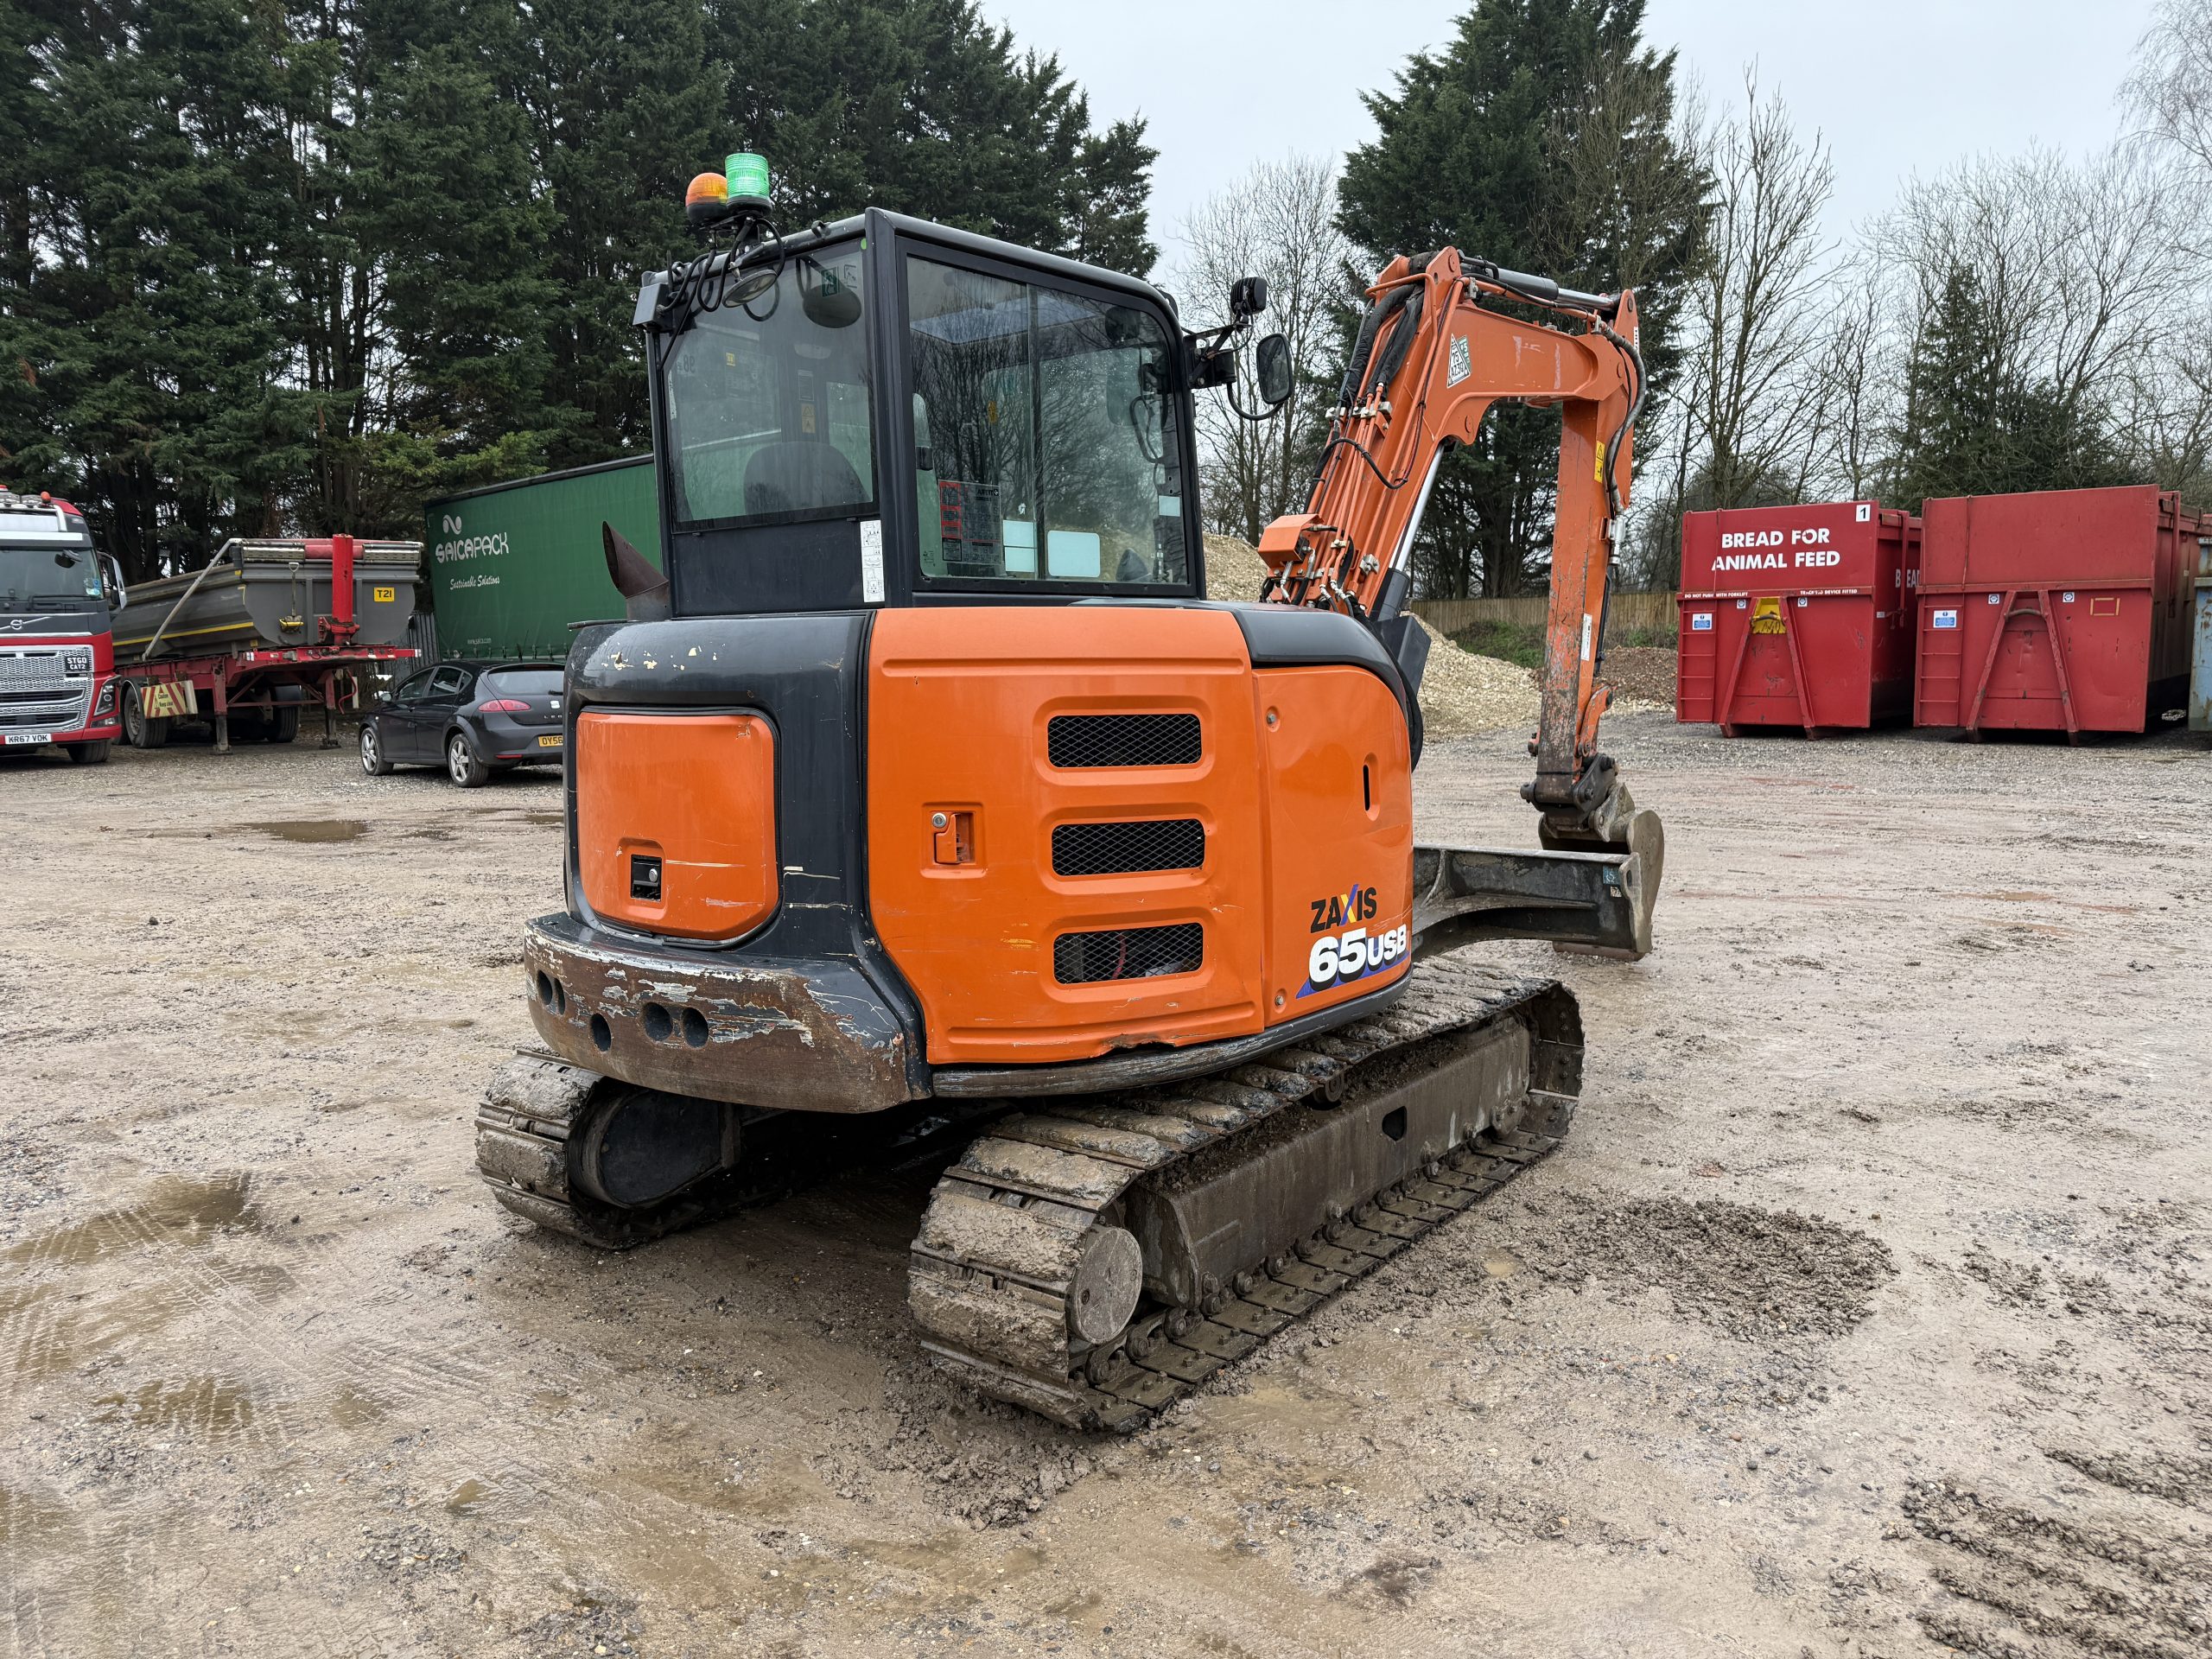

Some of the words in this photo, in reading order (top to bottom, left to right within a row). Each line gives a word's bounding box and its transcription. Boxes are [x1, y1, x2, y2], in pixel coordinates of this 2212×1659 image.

[1859, 507, 1866, 519] 1
[435, 531, 509, 563] SAICAPACK
[1721, 531, 1783, 549] BREAD
[1791, 528, 1830, 545] FOR
[1711, 552, 1788, 570] ANIMAL
[1795, 550, 1840, 568] FEED
[477, 575, 500, 587] Solutions
[1895, 569, 1920, 588] BEA
[377, 589, 392, 598] T21
[1310, 883, 1377, 933] ZAXIS
[1308, 924, 1408, 989] 65USB
